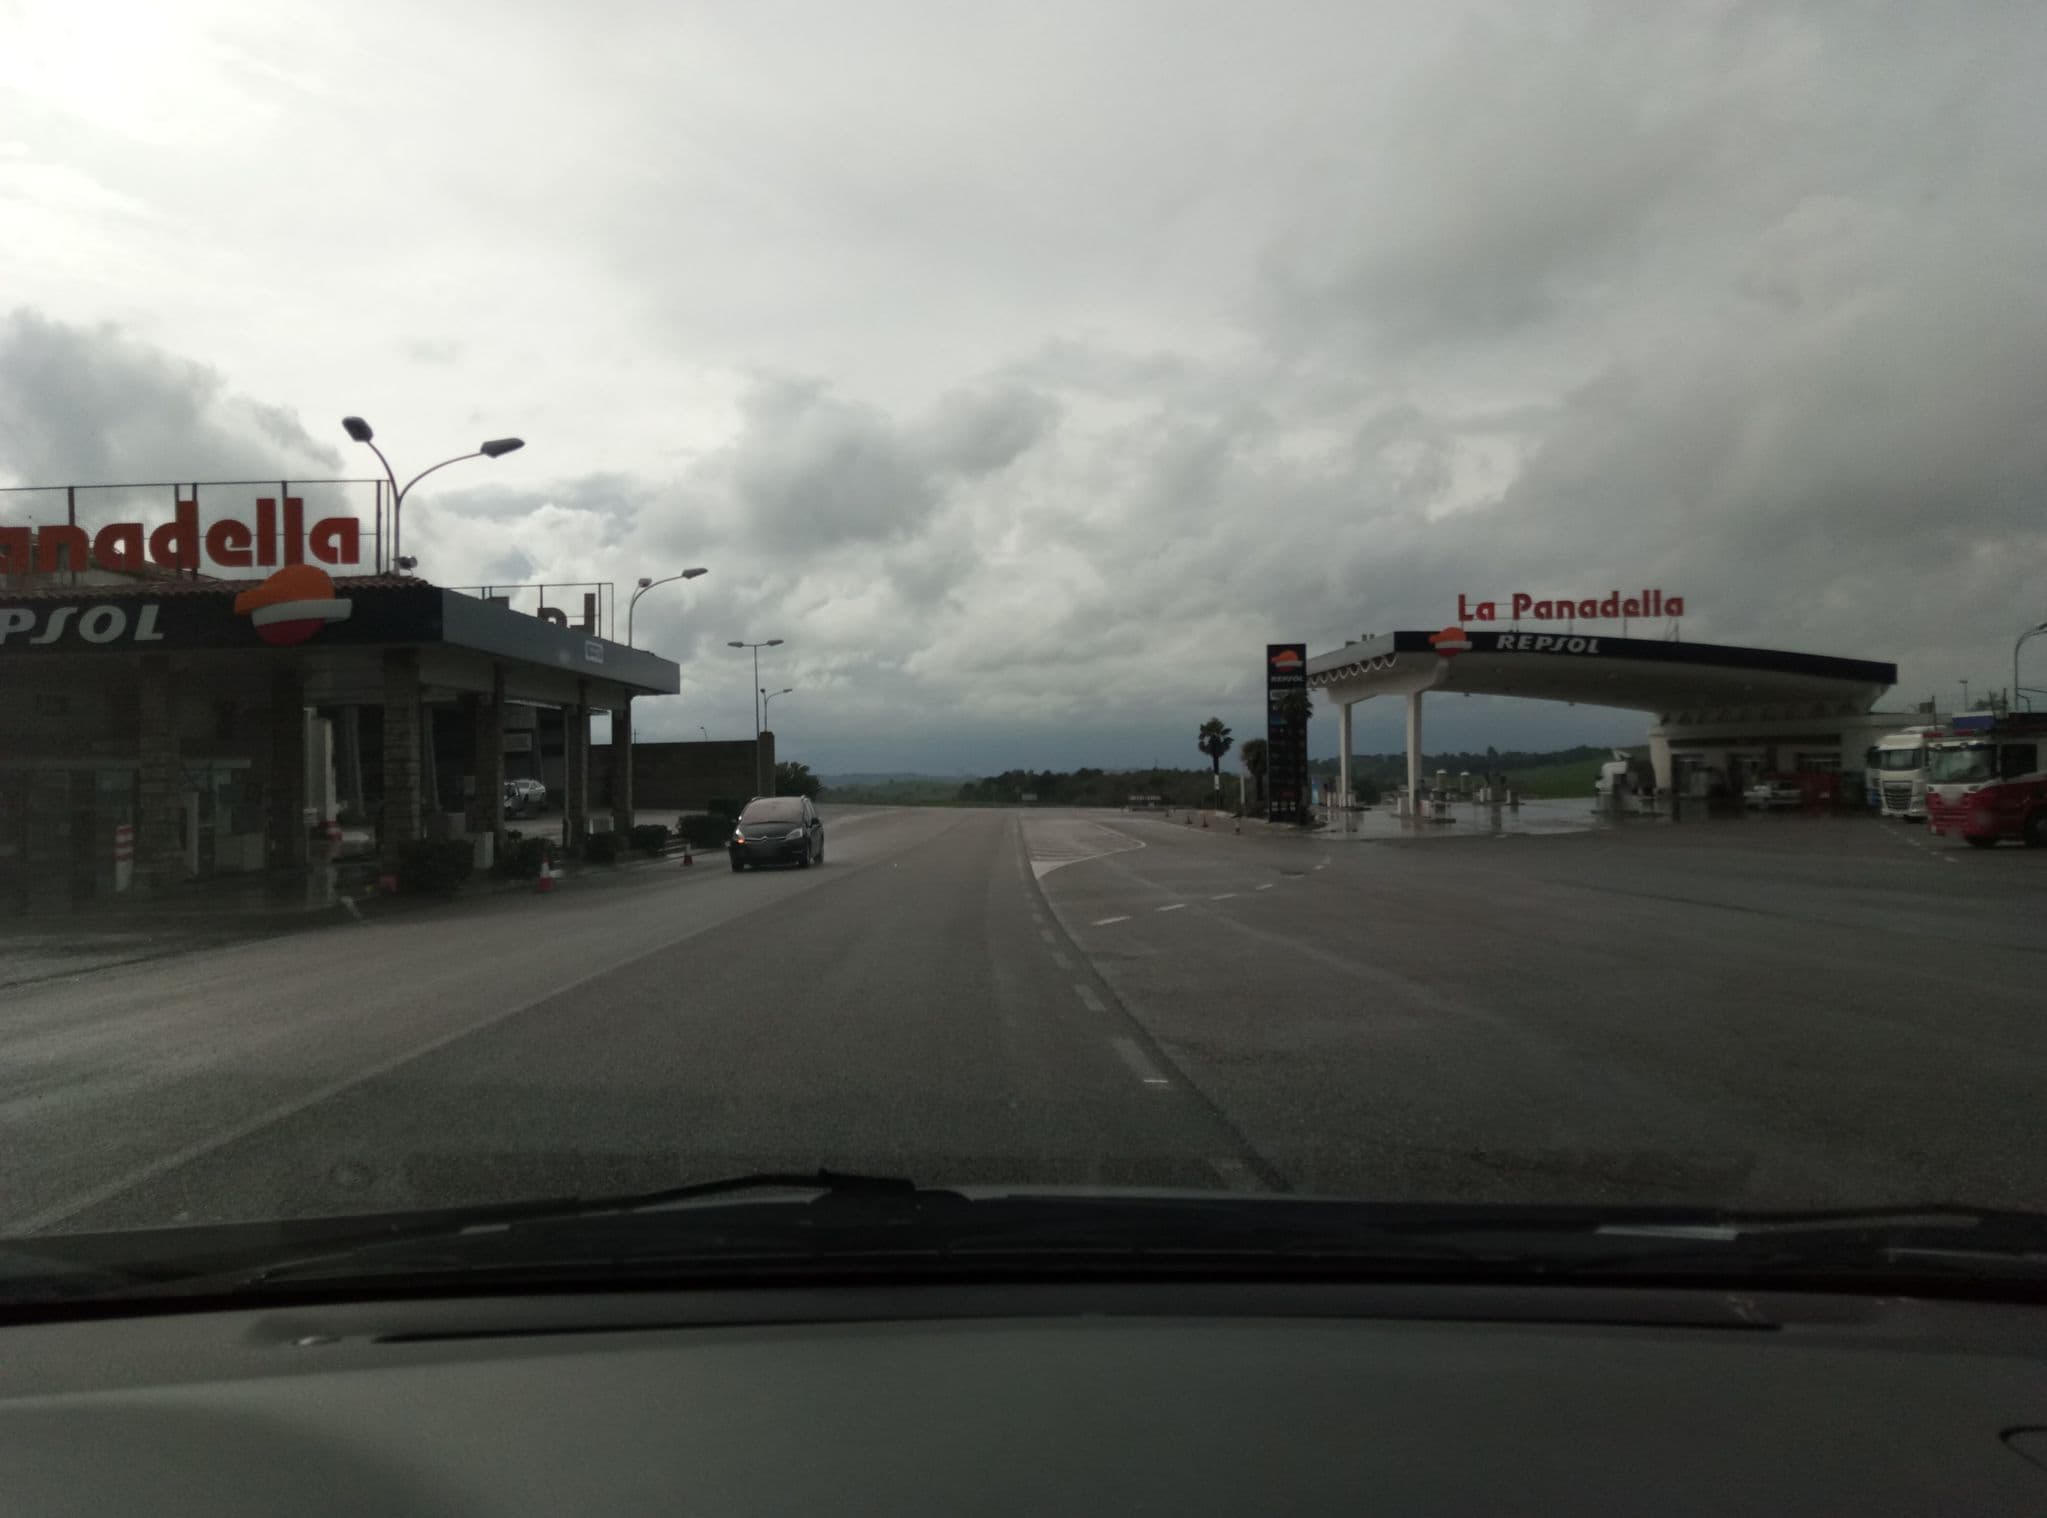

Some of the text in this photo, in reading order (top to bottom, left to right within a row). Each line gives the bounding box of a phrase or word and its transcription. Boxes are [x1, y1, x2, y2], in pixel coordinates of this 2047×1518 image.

[1459, 589, 1684, 621] La Panadella
[1497, 634, 1601, 654] REPSOL
